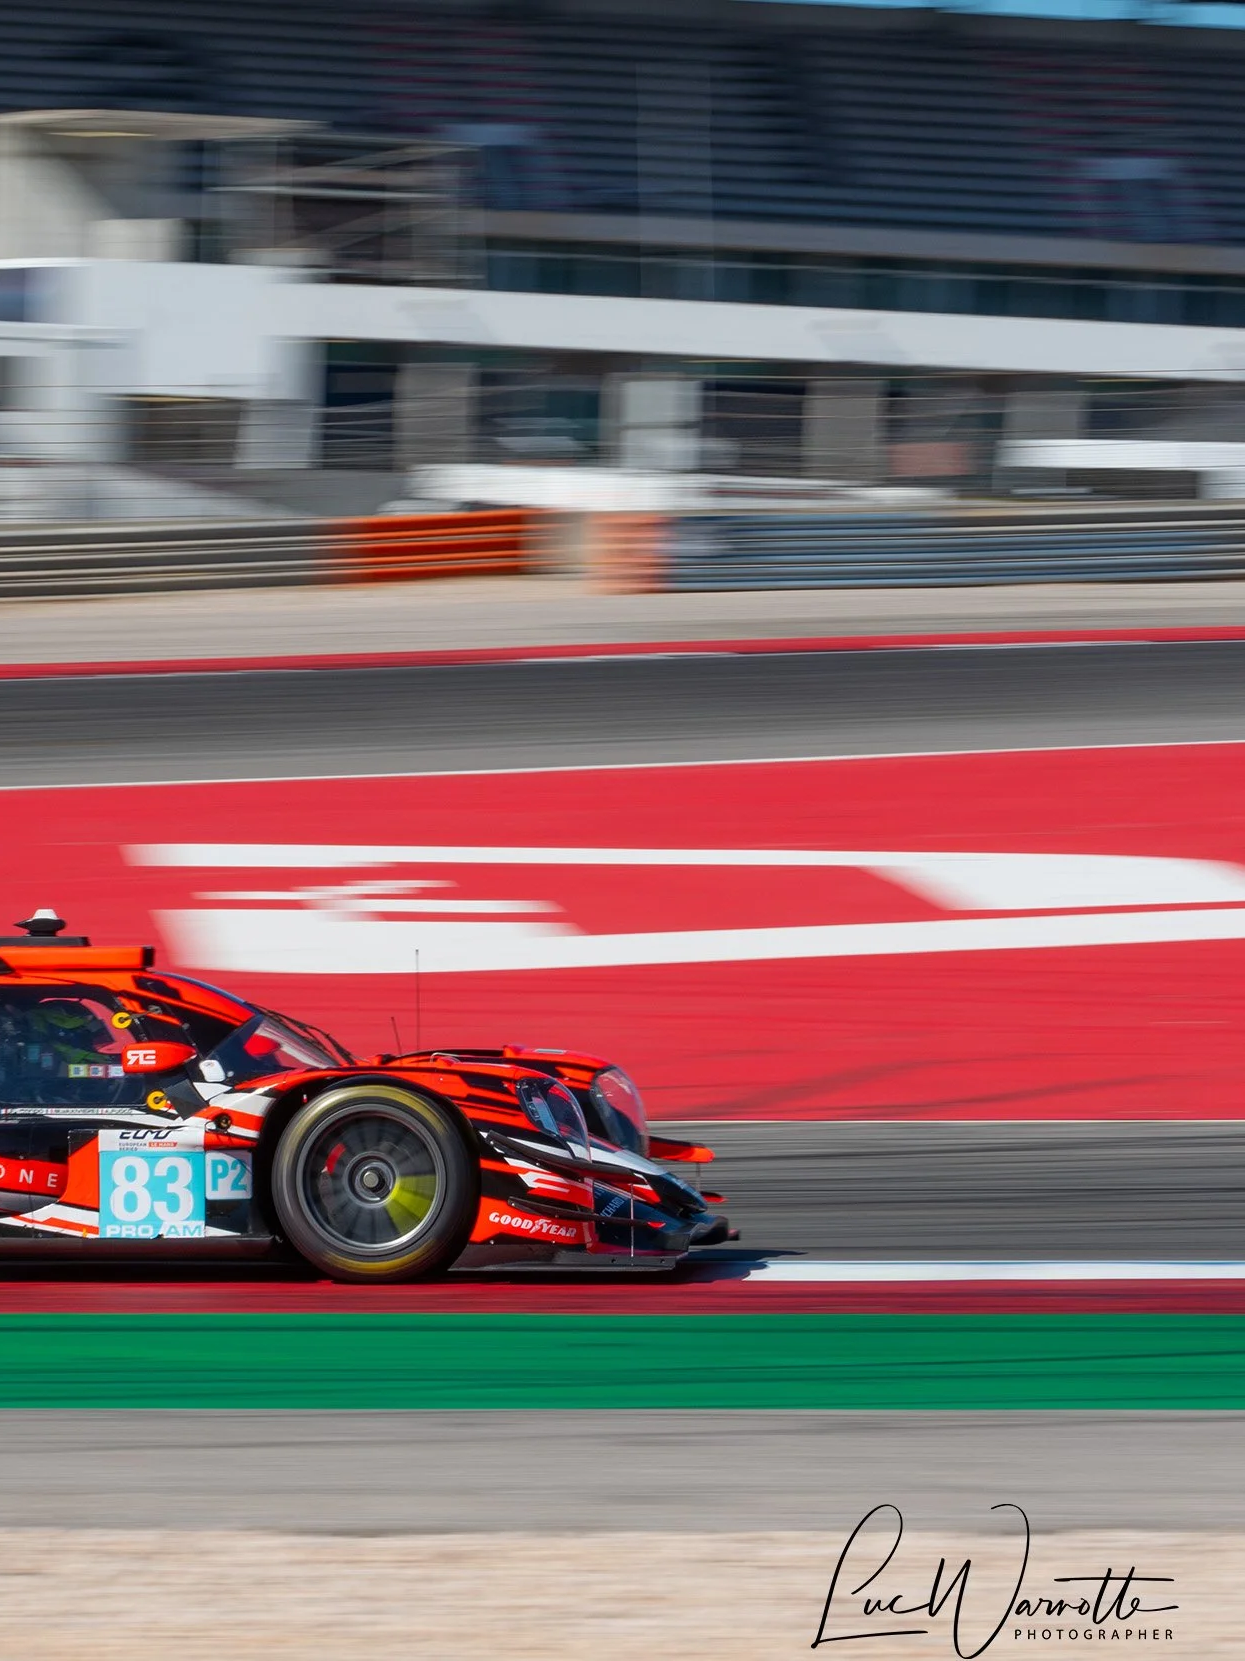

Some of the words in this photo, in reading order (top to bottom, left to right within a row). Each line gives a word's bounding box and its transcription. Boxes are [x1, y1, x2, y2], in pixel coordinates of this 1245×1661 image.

[110, 1156, 194, 1222] 83
[211, 1159, 247, 1191] P2
[106, 1225, 154, 1238] PRO
[166, 1225, 202, 1236] AM
[488, 1212, 577, 1238] GOODYEAR
